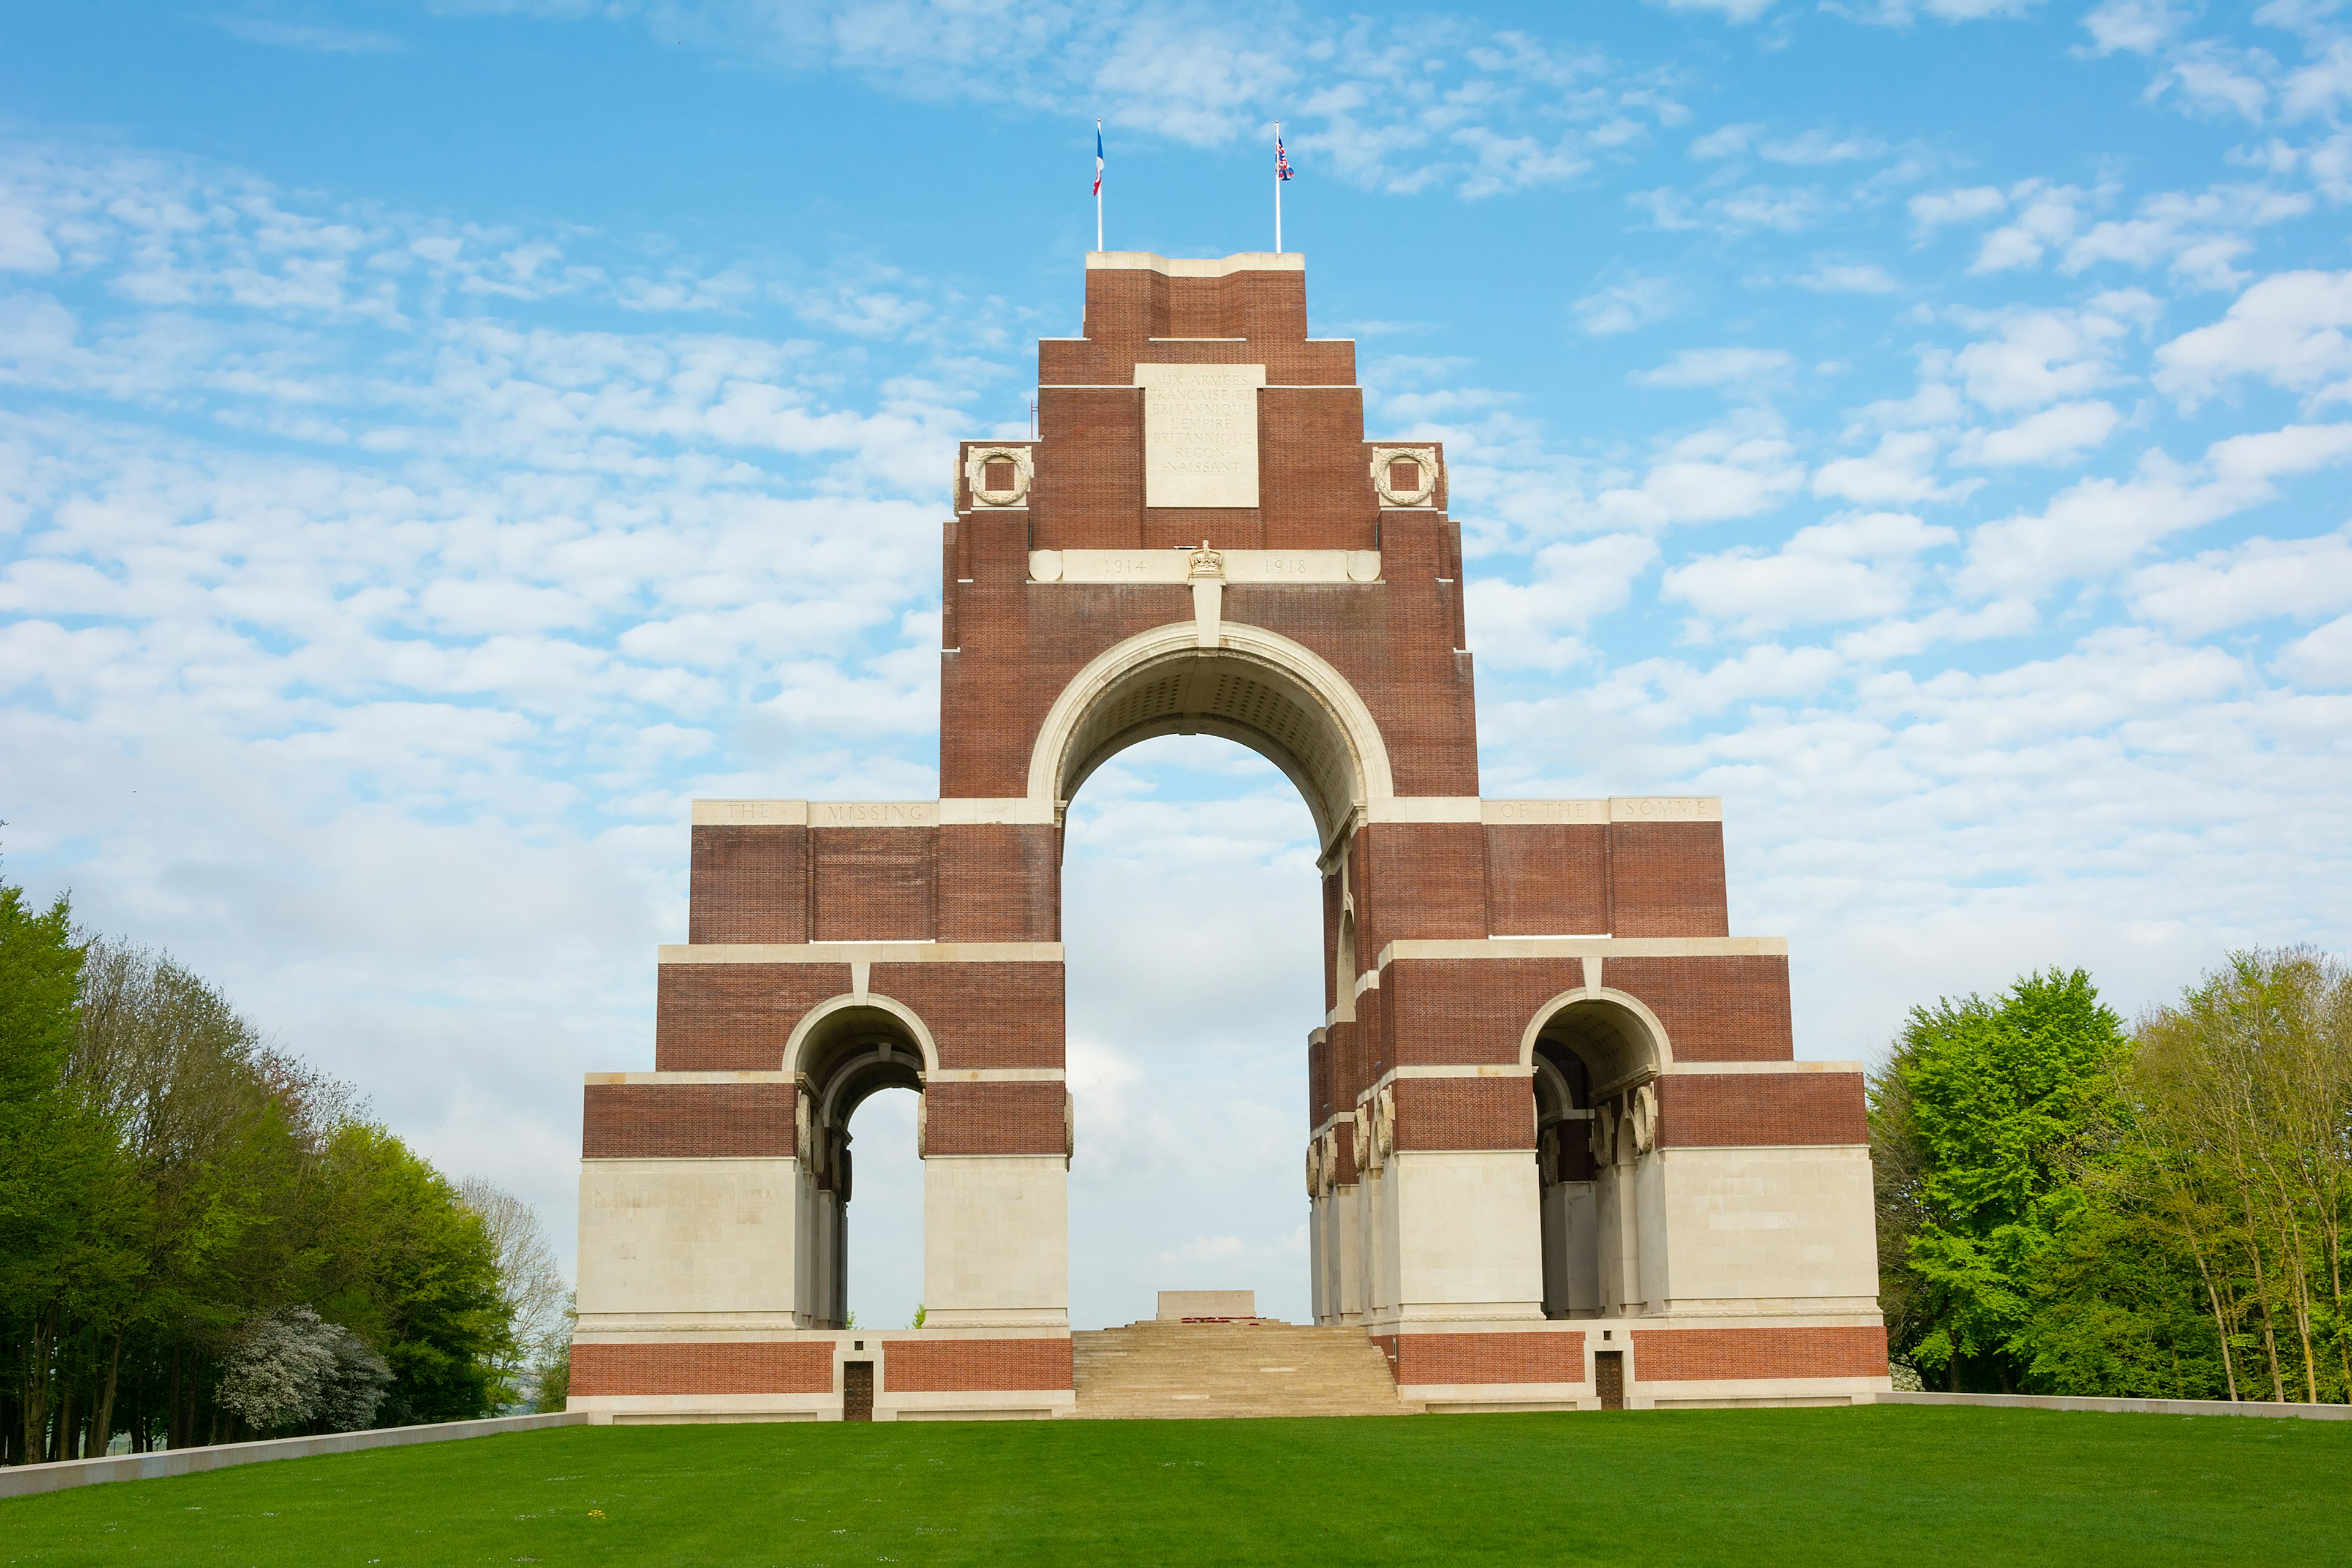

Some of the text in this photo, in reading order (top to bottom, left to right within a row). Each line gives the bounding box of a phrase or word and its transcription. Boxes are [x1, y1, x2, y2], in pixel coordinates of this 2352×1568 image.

[1152, 374, 1183, 385] AUX
[1237, 389, 1254, 401] ET
[1152, 403, 1251, 417] BRITANNIQUE
[1170, 417, 1232, 429] L'EMPIRE
[1153, 432, 1252, 445] BRITANNIQUE
[1175, 447, 1231, 458] RECON-
[1104, 559, 1147, 573] 1914
[1265, 559, 1306, 574] 1918
[725, 804, 922, 820] THE MISSING
[1501, 800, 1706, 818] OF THE SOMME
